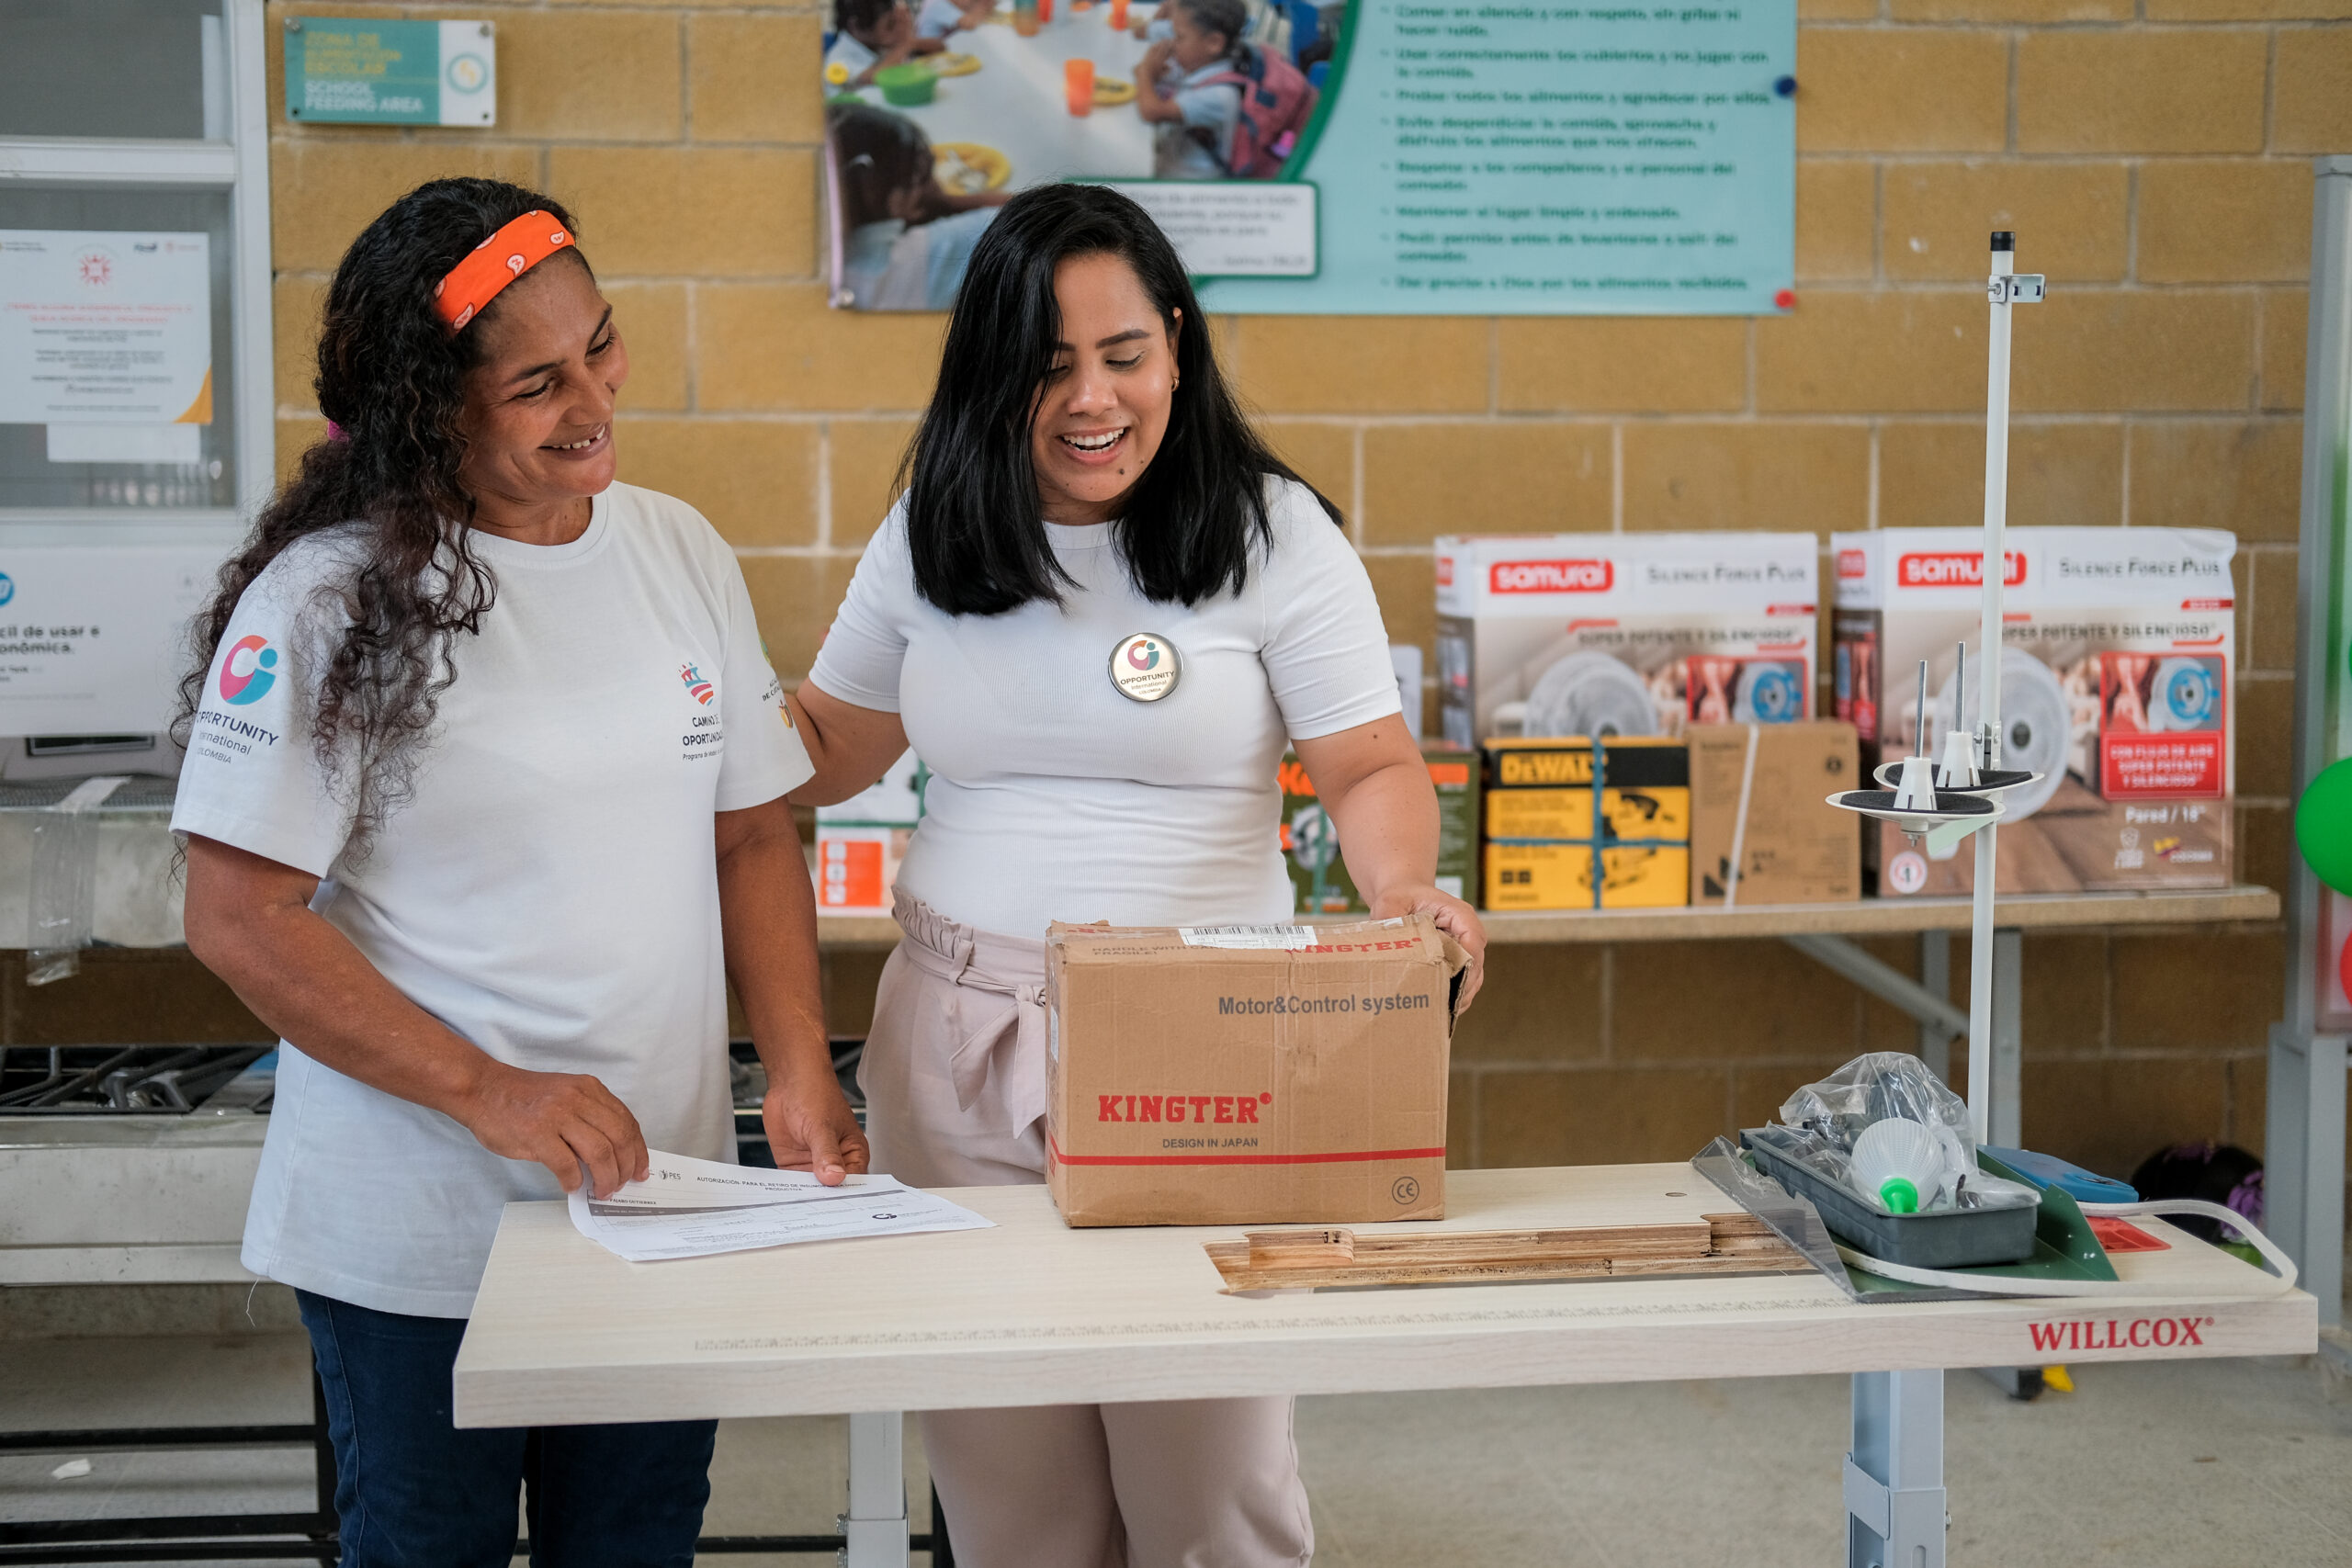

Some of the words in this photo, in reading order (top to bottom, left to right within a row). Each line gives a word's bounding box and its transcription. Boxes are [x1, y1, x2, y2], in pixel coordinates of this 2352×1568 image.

[305, 81, 374, 96] SCHOOL
[305, 96, 376, 111] FEEDING
[379, 97, 424, 112] AREA
[1497, 560, 1606, 589] samurai
[1120, 671, 1175, 685] OPPORTUNITY
[2125, 805, 2169, 823] Pared
[1218, 994, 1356, 1015] Motor&Control
[1362, 993, 1430, 1016] system
[1162, 1138, 1204, 1148] DESIGN
[1207, 1138, 1219, 1148] IN
[1221, 1137, 1259, 1148] JAPAN
[669, 1172, 682, 1180] PES
